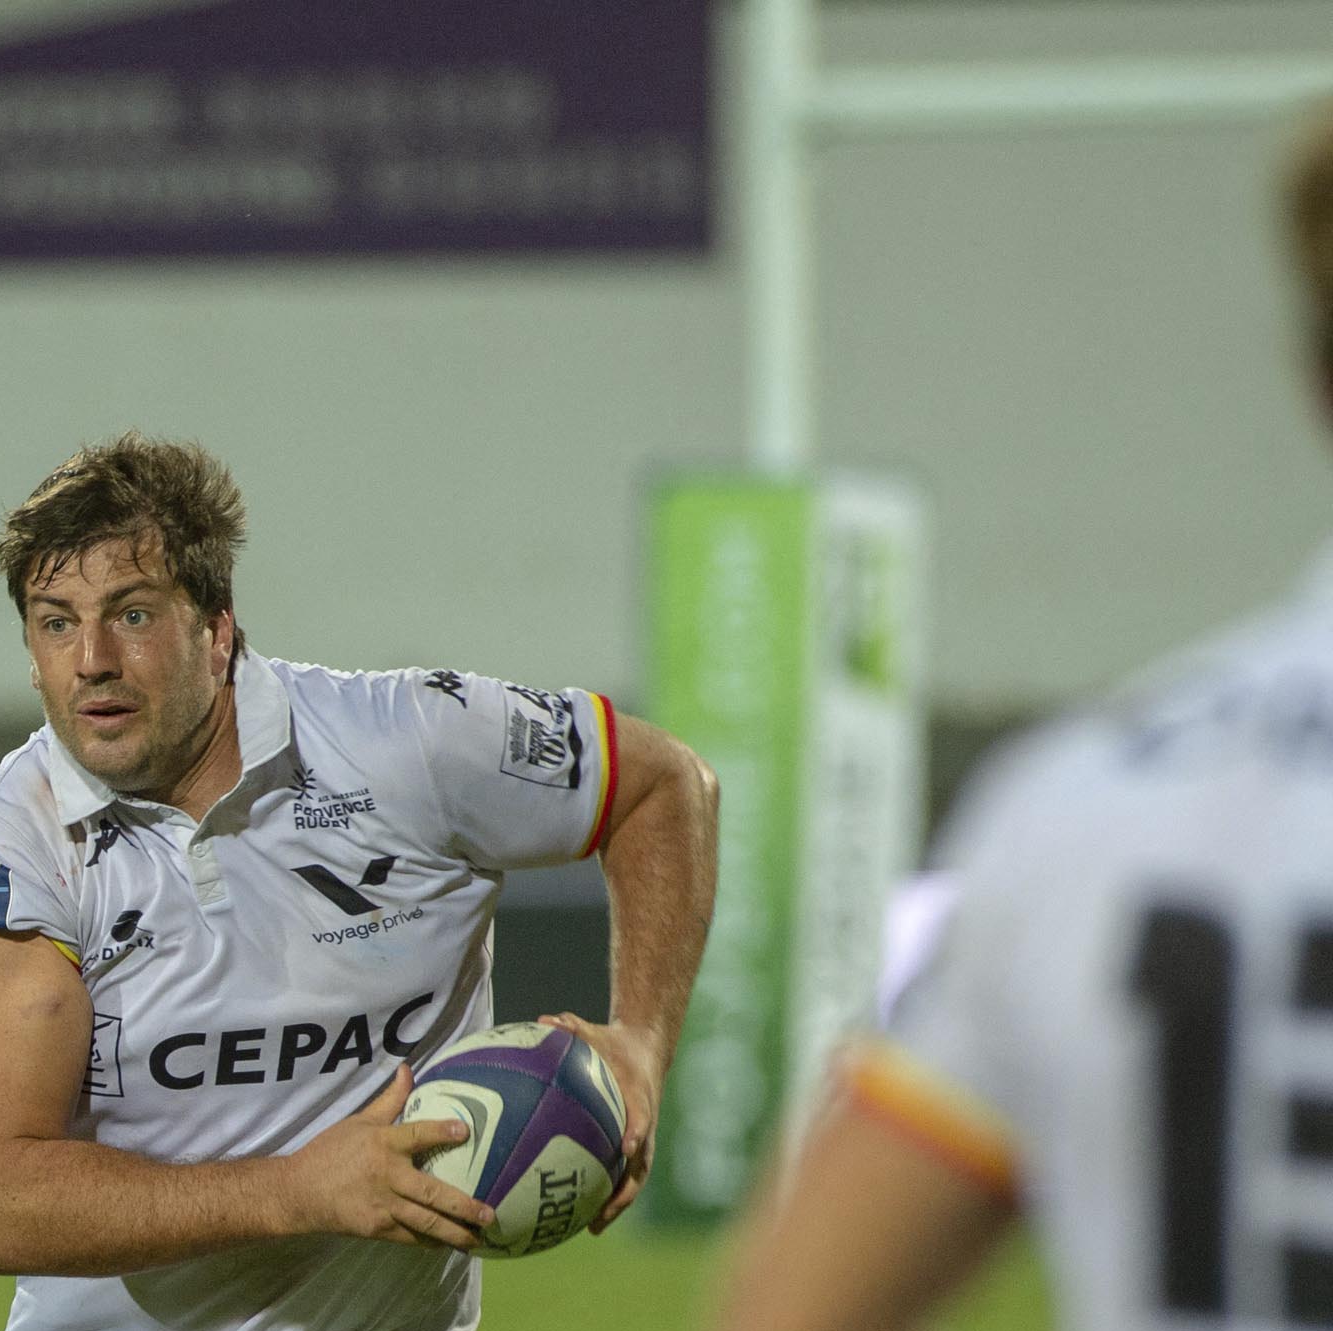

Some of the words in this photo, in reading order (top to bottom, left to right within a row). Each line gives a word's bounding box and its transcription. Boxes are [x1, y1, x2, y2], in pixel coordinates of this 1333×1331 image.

[312, 921, 380, 945] voyage
[382, 905, 424, 933] privé
[148, 990, 435, 1090] CEPAC
